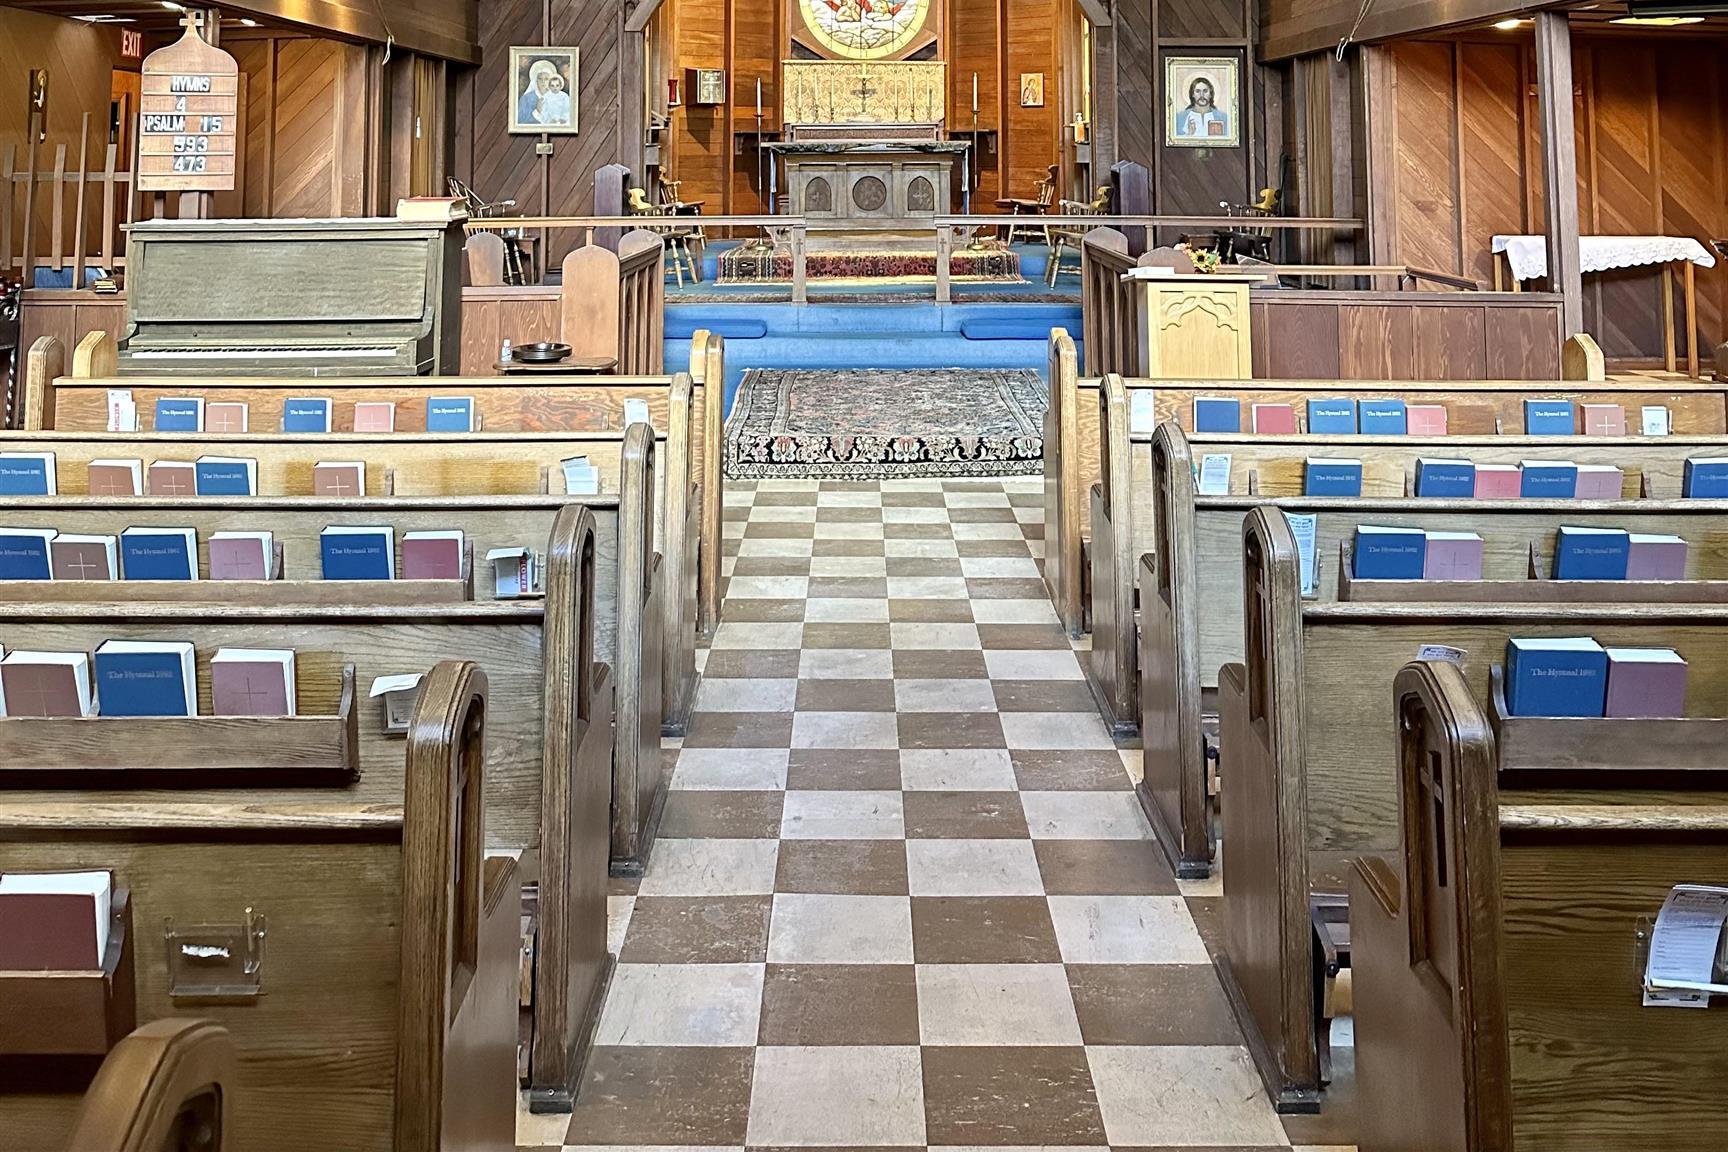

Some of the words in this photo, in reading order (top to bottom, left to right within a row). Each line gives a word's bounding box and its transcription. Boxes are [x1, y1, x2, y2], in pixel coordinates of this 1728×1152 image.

[122, 30, 142, 57] EXIT
[172, 75, 211, 92] HYMNS
[176, 95, 186, 112] 4
[146, 115, 184, 132] PSALM
[174, 136, 208, 152] 593
[174, 156, 207, 172] 473
[105, 670, 124, 679] The
[1530, 668, 1547, 677] The
[1547, 668, 1578, 678] Hymnal
